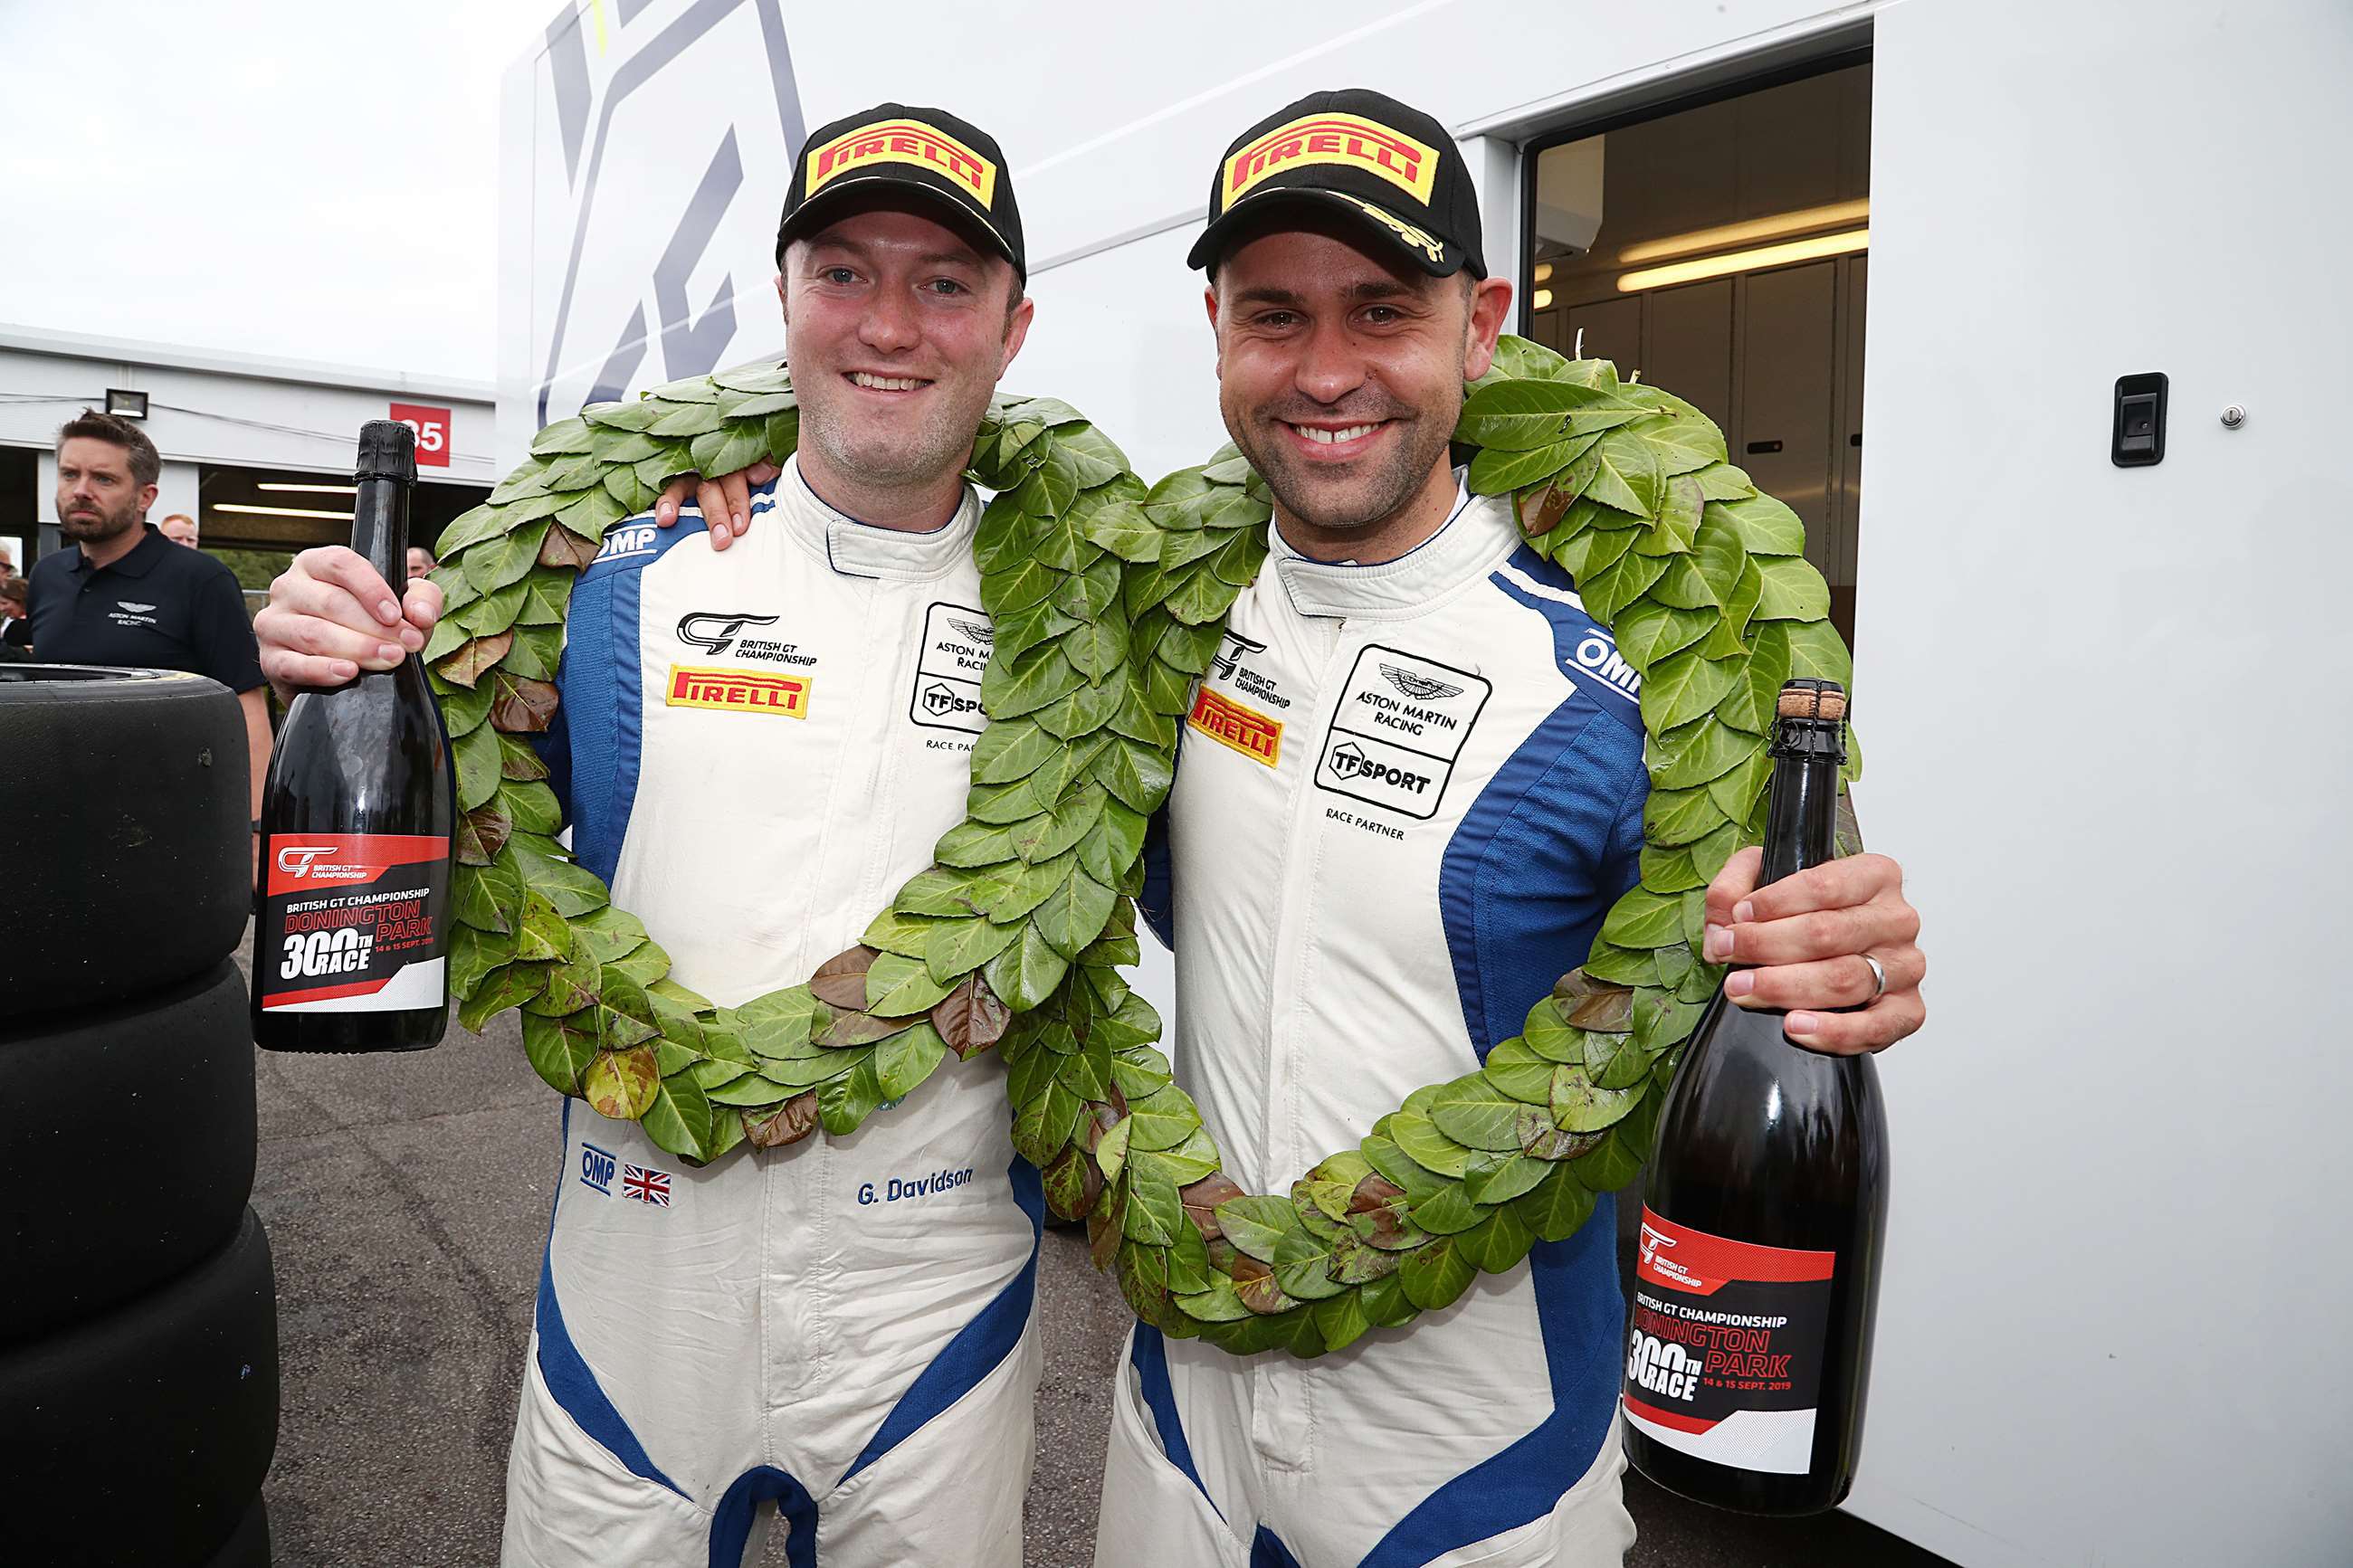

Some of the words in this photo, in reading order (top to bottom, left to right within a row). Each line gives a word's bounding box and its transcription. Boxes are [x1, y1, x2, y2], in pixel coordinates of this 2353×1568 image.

[817, 126, 984, 190] PIRELLI
[1232, 120, 1423, 192] PIRELLI
[736, 649, 817, 666] CHAMPIONSHIP
[739, 640, 781, 651] BRITISH
[782, 643, 797, 653] GT
[937, 641, 975, 656] ASTON
[957, 657, 986, 670] RACI
[673, 672, 803, 709] PIRELLI
[1239, 667, 1265, 688] BRITISH
[1266, 679, 1277, 691] GT
[1235, 679, 1291, 709] CHAMPIONSHIP
[1356, 691, 1400, 712] ASTON
[1403, 705, 1457, 730] MARTIN
[1374, 712, 1424, 736] RACING
[1193, 693, 1277, 757] PIRELLI
[927, 739, 953, 750] RACE
[1326, 808, 1353, 824] RACE
[1355, 818, 1405, 841] PARTNER
[313, 864, 342, 872] BRITISH
[287, 899, 327, 914] BRITISH
[329, 898, 344, 908] GT
[348, 888, 430, 907] CHAMPIONSHIP
[285, 900, 421, 934] DONINGTON
[376, 916, 433, 943] PARK
[319, 948, 371, 975] RACE
[582, 1150, 615, 1187] OMP
[858, 1183, 879, 1205] G.
[887, 1168, 973, 1202] Davidson
[1653, 1263, 1701, 1288] CHAMPIONSHIP
[1655, 1254, 1678, 1271] BRITISH
[1678, 1266, 1689, 1275] GT
[1637, 1291, 1662, 1312] BRITISH
[1663, 1303, 1678, 1316] GT
[1679, 1307, 1787, 1328] CHAMPIONSHIP
[1704, 1350, 1792, 1377] PARK
[1649, 1364, 1698, 1402] RACE
[1703, 1377, 1714, 1386] 14
[1725, 1381, 1736, 1389] 15
[1738, 1381, 1766, 1390] SEPT.
[1767, 1382, 1792, 1390] 2019
